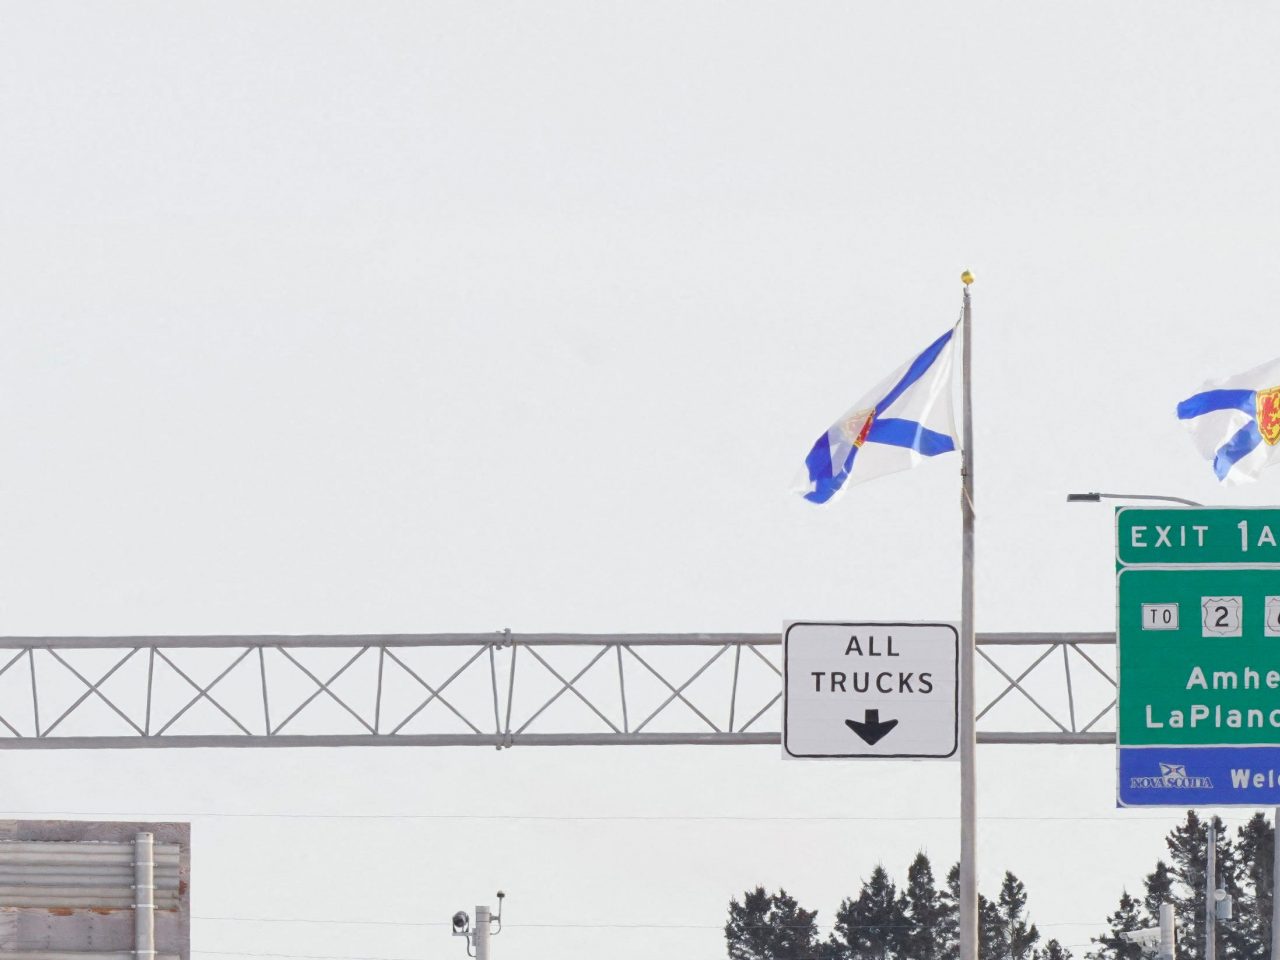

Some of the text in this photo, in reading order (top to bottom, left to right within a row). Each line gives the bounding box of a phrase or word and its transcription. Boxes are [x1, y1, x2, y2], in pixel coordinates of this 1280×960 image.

[1131, 520, 1277, 552] EXIT 1A
[1150, 608, 1172, 624] TO
[1214, 605, 1230, 628] 2
[844, 635, 900, 657] ALL
[811, 671, 934, 694] TRUCKS
